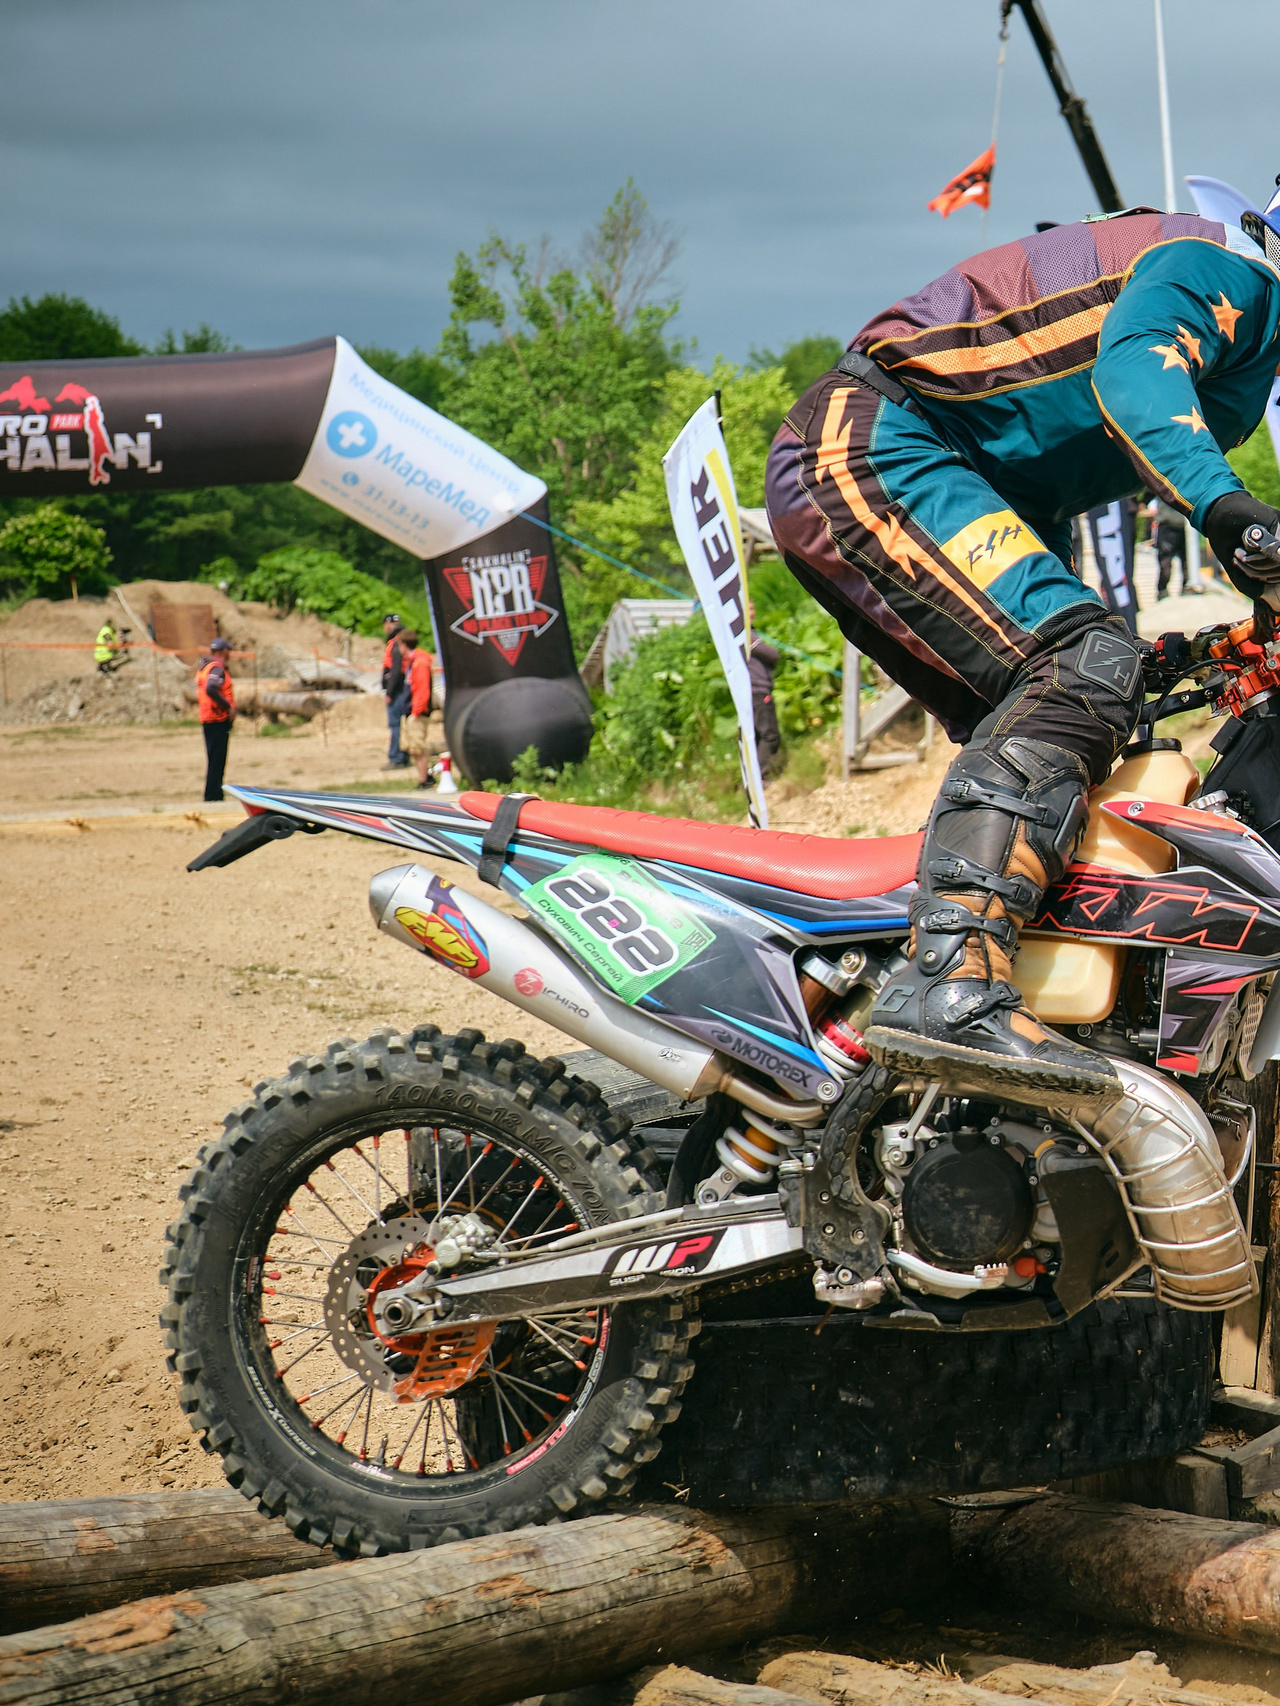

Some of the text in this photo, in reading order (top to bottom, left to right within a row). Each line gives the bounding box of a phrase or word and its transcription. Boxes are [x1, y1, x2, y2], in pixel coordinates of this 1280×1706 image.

[376, 443, 491, 528] МареМед
[547, 868, 677, 974] 222
[542, 986, 590, 1019] ICHIRO
[731, 1037, 813, 1088] MOTOREX
[611, 1235, 714, 1277] WP
[507, 1444, 548, 1476] TRACTION
